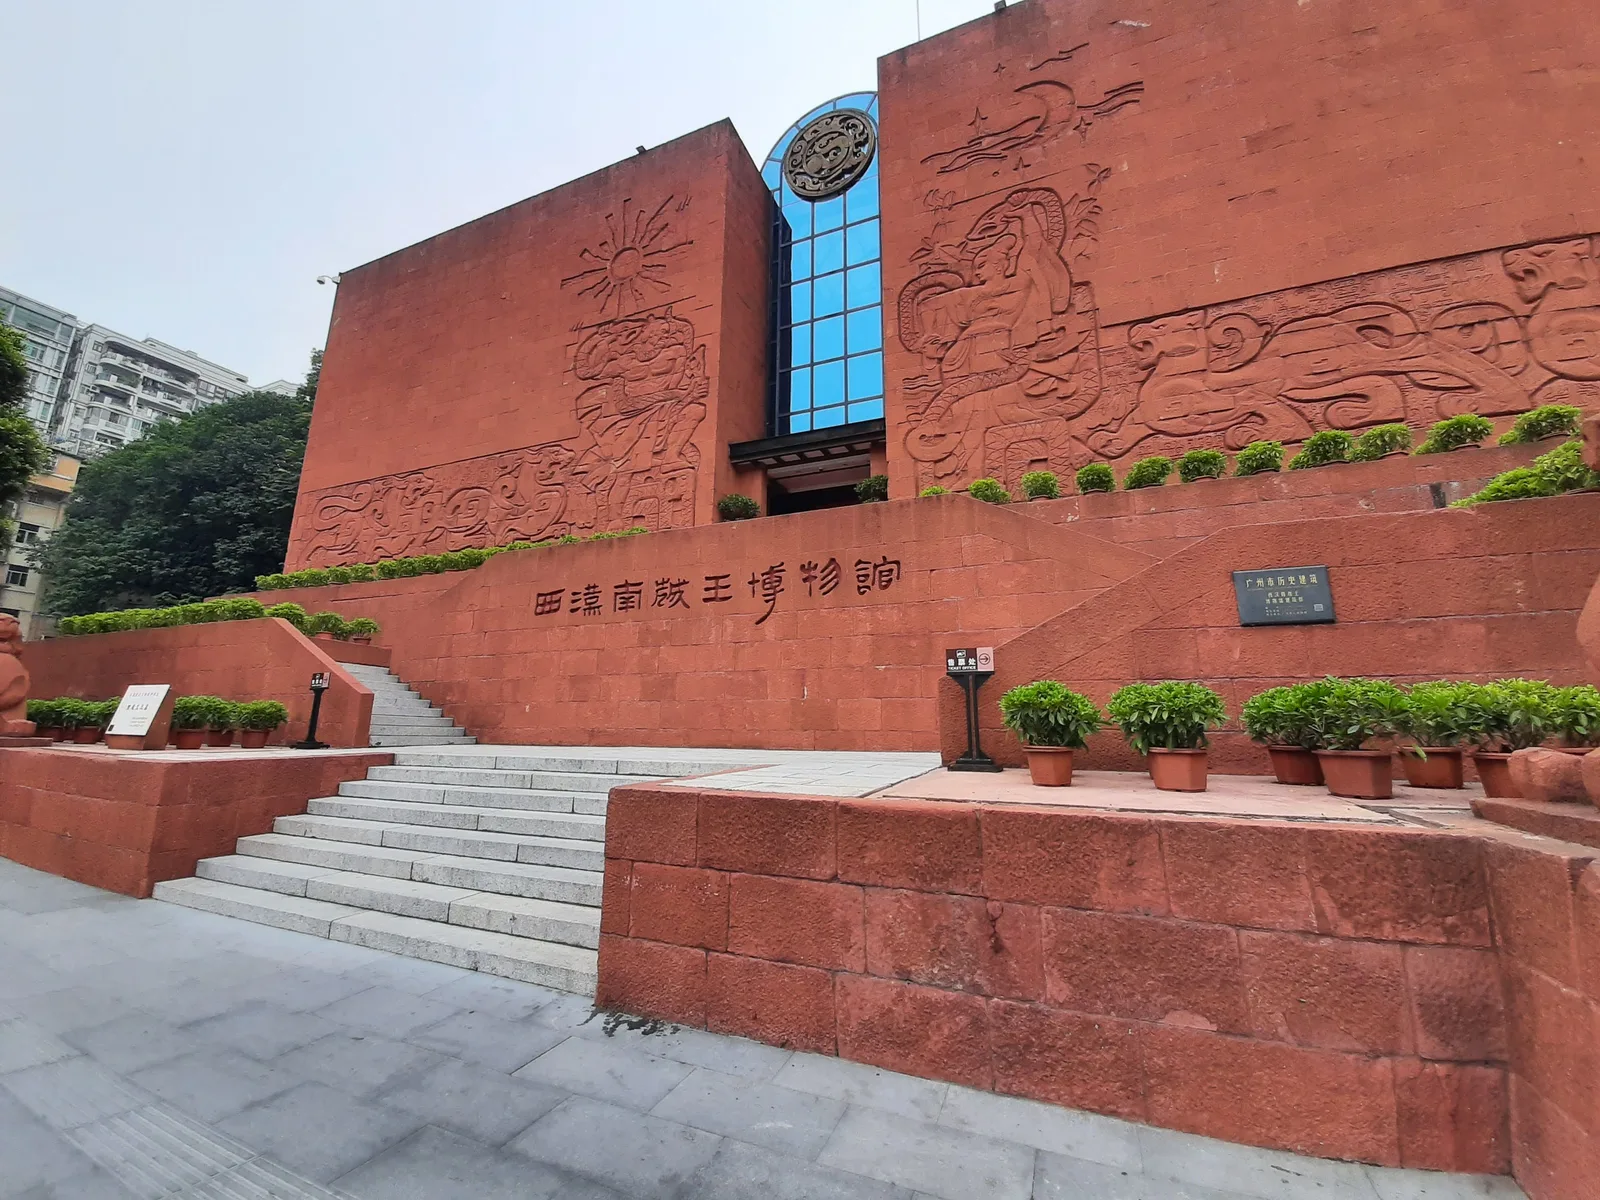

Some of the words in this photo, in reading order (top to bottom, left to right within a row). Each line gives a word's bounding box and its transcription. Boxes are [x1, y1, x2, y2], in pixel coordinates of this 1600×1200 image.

[1246, 574, 1318, 588] 广州市历史建筑
